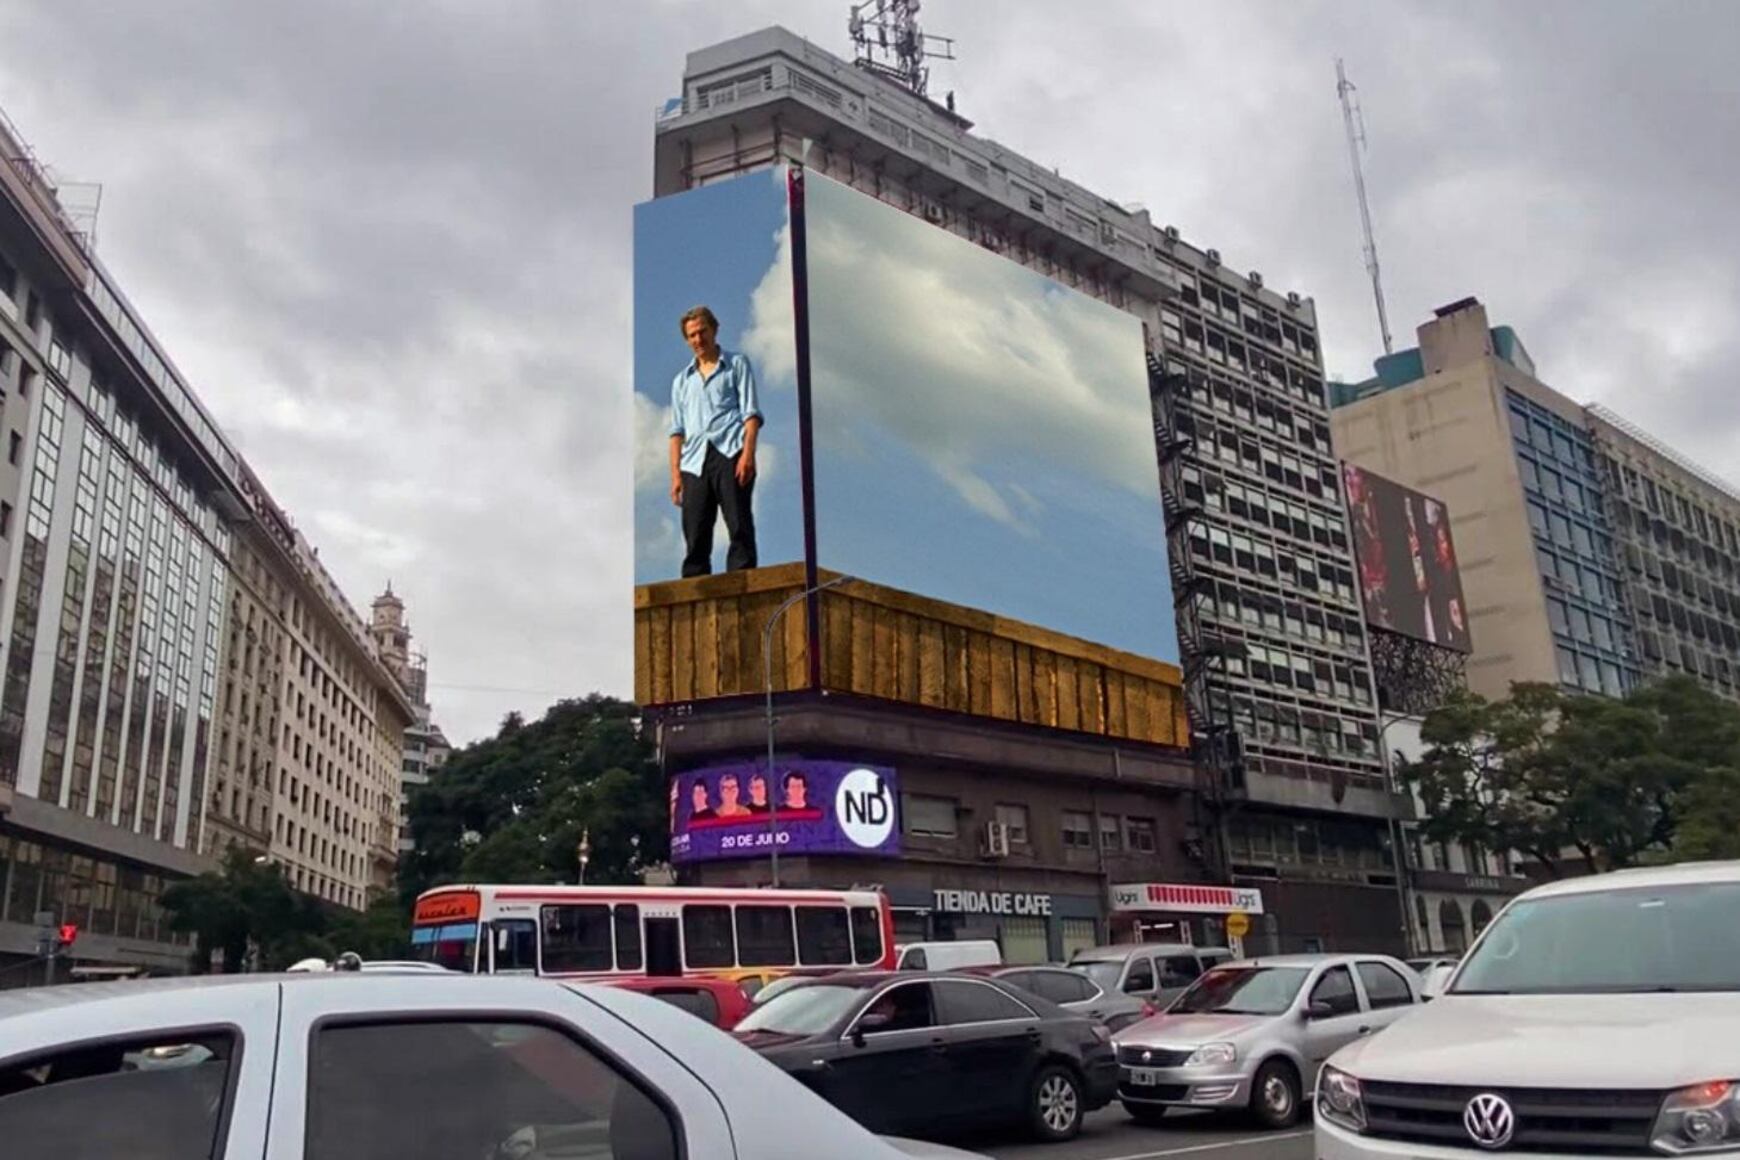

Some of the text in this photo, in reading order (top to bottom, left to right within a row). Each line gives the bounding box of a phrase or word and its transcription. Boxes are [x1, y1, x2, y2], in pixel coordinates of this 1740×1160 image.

[721, 835, 735, 848] 20
[736, 833, 753, 847] DE
[933, 889, 1052, 915] TIENDA DE CAFE
